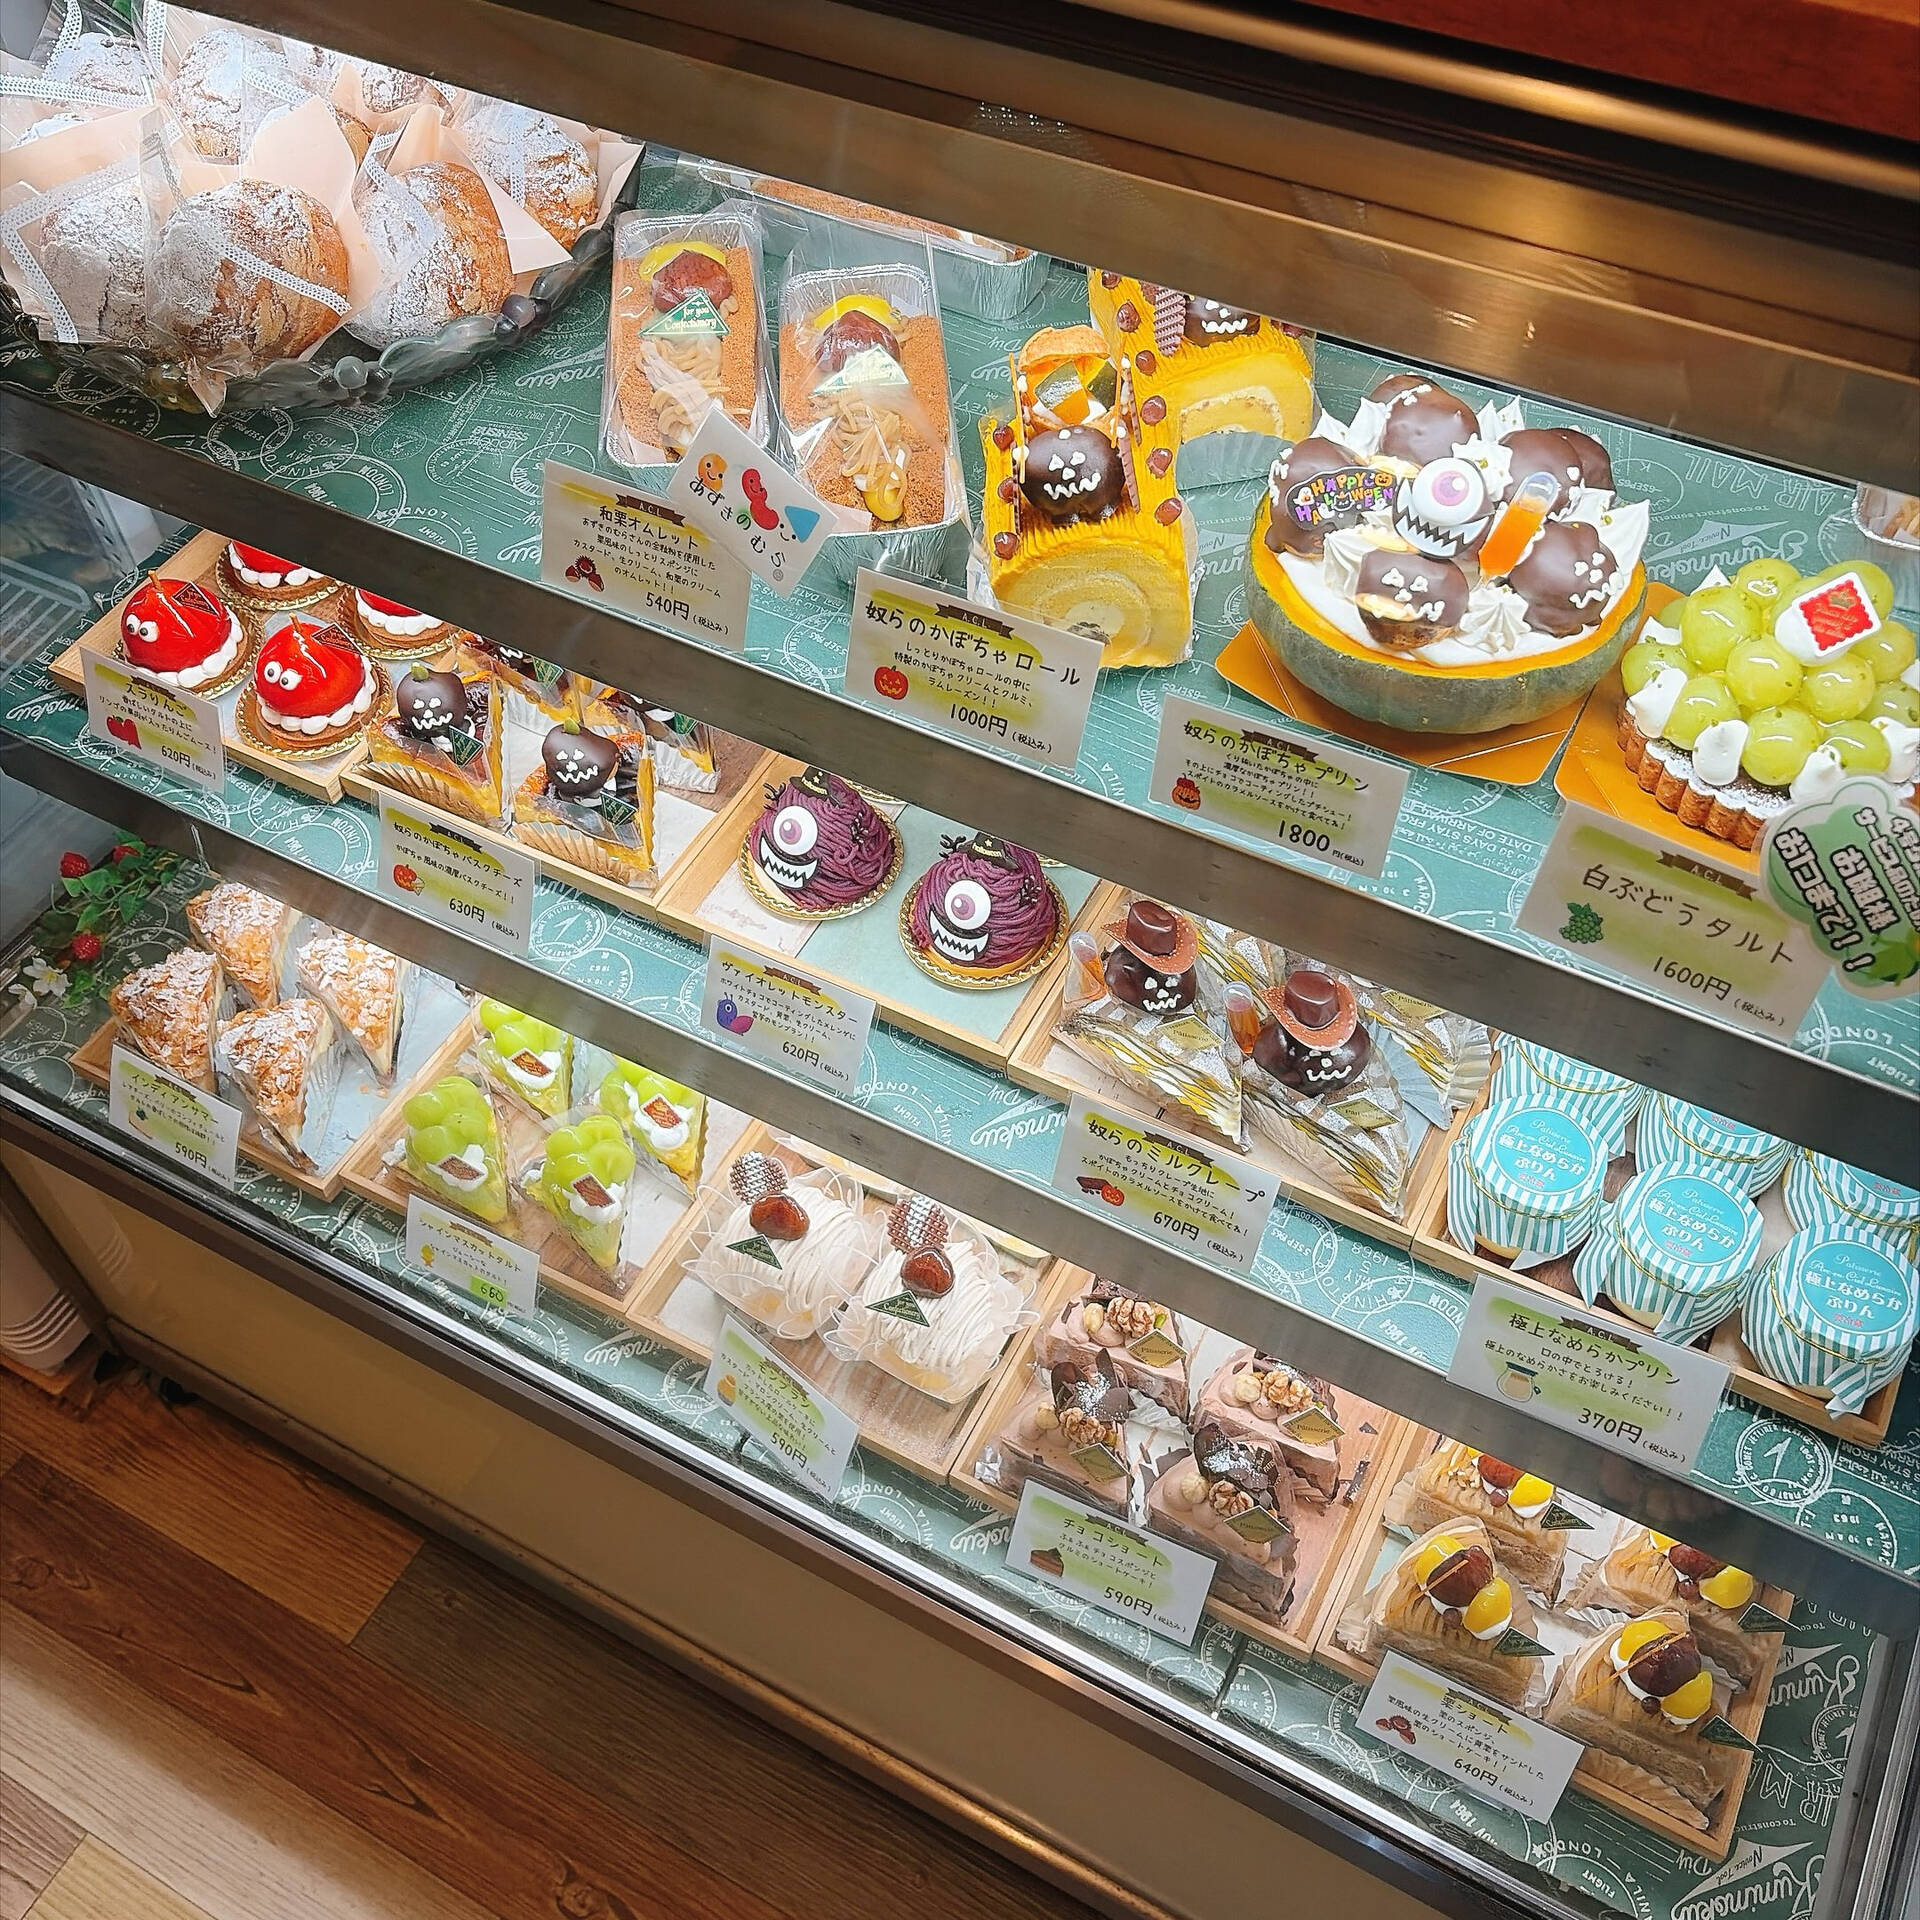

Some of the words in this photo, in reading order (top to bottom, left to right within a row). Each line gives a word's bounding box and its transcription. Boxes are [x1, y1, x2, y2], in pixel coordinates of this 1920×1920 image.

[1310, 472, 1367, 497] HAPPY
[1685, 452, 1768, 498] MAIL
[1775, 478, 1835, 516] AIR
[600, 505, 698, 549] 和栗オムレット
[689, 476, 786, 567] あずきのむら
[645, 592, 690, 621] 540円
[865, 601, 1081, 686] 奴らのかぼちゃロール
[906, 642, 1031, 691] しっとりかぼちゃロールの中に
[125, 683, 188, 717] スラりんご
[950, 704, 1008, 736] 1000円
[161, 745, 191, 768] 620円
[1183, 721, 1369, 792] 奴らのかぼちゃプリン
[1400, 814, 1427, 828] FRO
[1428, 825, 1462, 841] STAY
[1478, 829, 1501, 844] OF
[1464, 836, 1497, 853] DAYS
[1503, 836, 1532, 853] DATE
[449, 897, 485, 923] 630円
[1582, 863, 1793, 964] 白ぶどうタルト
[722, 961, 857, 1023] ヴァイオレットモンスター
[1653, 956, 1732, 1000] 1600円
[782, 1042, 820, 1067] 620円
[132, 1074, 219, 1124] インディアンサマー
[988, 1084, 1022, 1106] Diy
[893, 1105, 921, 1128] FLIGHT
[175, 1142, 207, 1169] 590円
[1088, 1119, 1266, 1202] 奴らのミルクレープ
[1499, 1133, 1585, 1176] 極上なめらか
[1514, 1156, 1556, 1181] ぷりん
[1153, 1211, 1200, 1241] 670円
[1648, 1197, 1735, 1249] 極上なめらか
[1662, 1223, 1704, 1252] ぷりん
[1805, 1270, 1903, 1311] 極上なめらか
[1826, 1295, 1875, 1319] ぷりん
[1508, 1312, 1681, 1385] 極上なめらかプリン
[758, 1361, 811, 1408] モンブラン
[1577, 1407, 1643, 1444] 370円
[771, 1432, 808, 1468] 590円
[1063, 1518, 1164, 1568] チョコショート
[1104, 1586, 1153, 1616] 590円
[1440, 1697, 1509, 1734] 栗ショート
[1454, 1757, 1498, 1786] 640円
